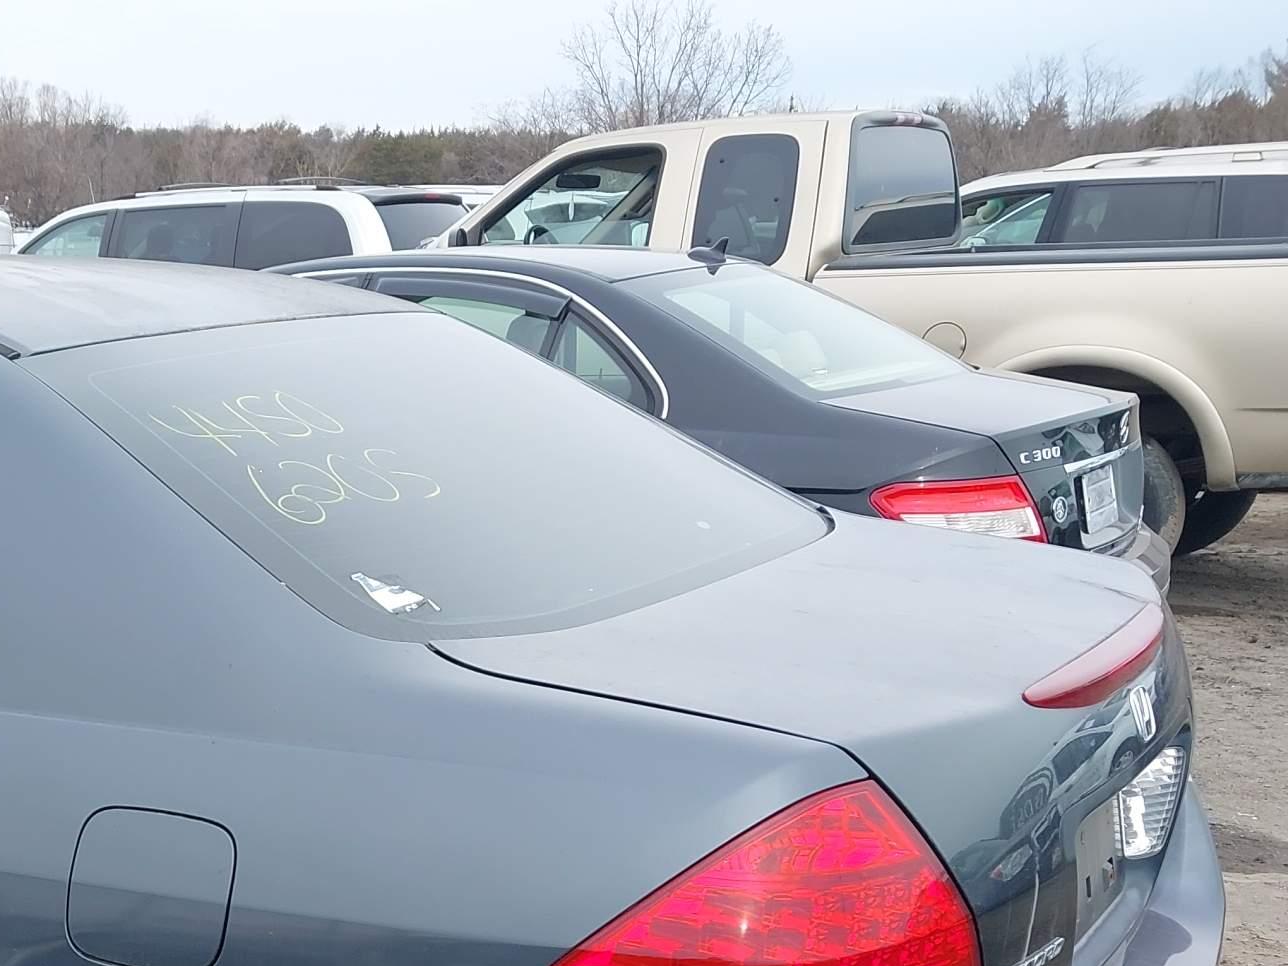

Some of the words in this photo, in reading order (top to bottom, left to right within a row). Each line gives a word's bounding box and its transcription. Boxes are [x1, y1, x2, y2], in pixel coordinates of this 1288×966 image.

[147, 390, 344, 456] 4450
[1019, 452, 1031, 464] C
[1032, 446, 1061, 462] 300
[246, 448, 441, 525] 6205
